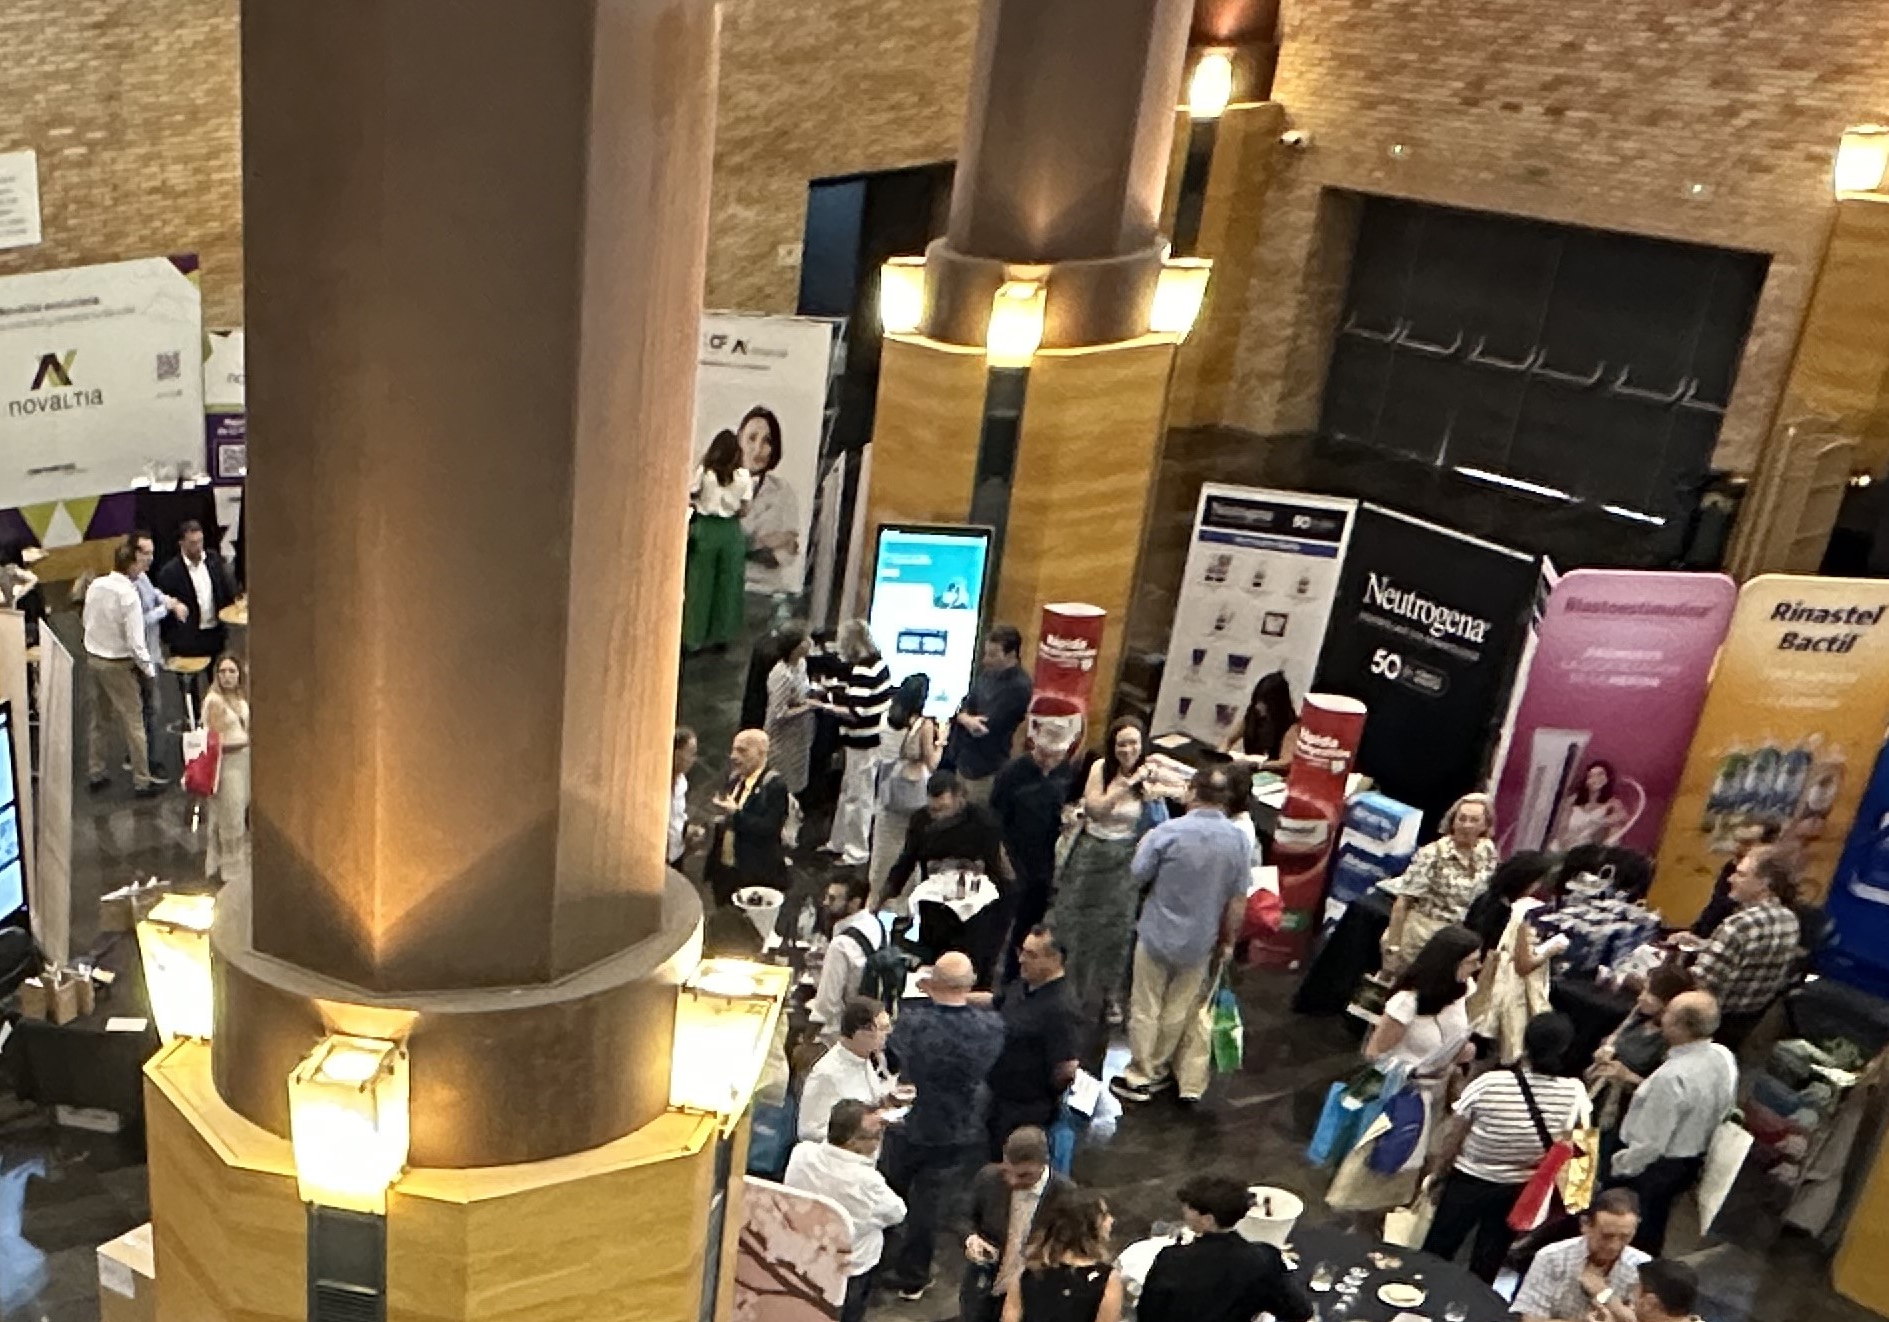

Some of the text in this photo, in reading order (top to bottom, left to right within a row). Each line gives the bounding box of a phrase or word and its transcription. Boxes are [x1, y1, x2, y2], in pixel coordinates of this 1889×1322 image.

[1362, 571, 1486, 643] Neutrogena
[1770, 600, 1884, 626] Rinastel
[1777, 631, 1858, 654] Bactil
[1370, 648, 1402, 681] 50
